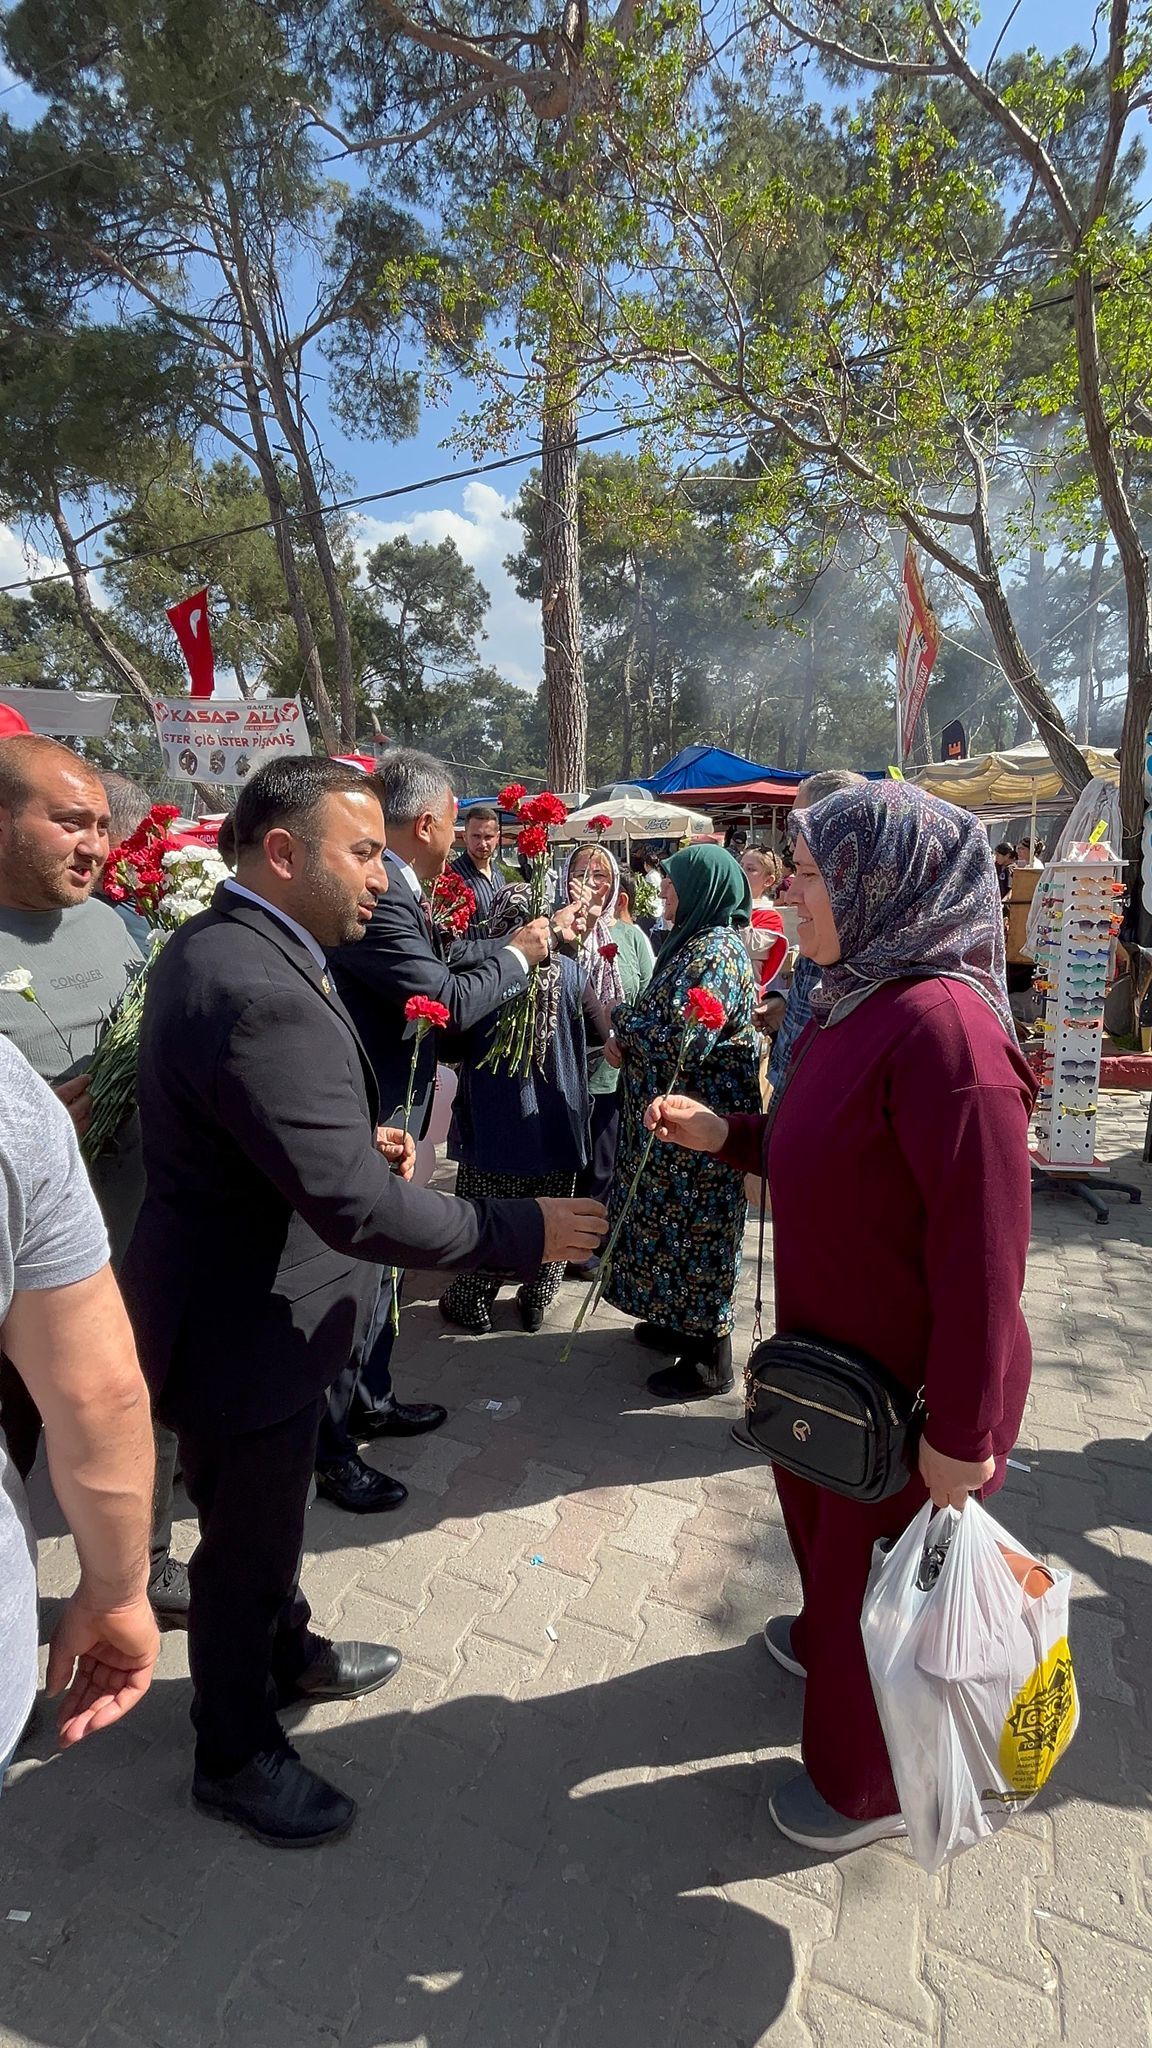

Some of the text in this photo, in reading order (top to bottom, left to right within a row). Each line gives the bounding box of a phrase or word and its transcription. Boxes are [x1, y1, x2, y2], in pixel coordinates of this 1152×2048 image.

[171, 710, 240, 723] KASAP
[194, 734, 215, 747] ÇİĞ
[217, 734, 249, 747] İSTER
[50, 968, 103, 989] CONQUER
